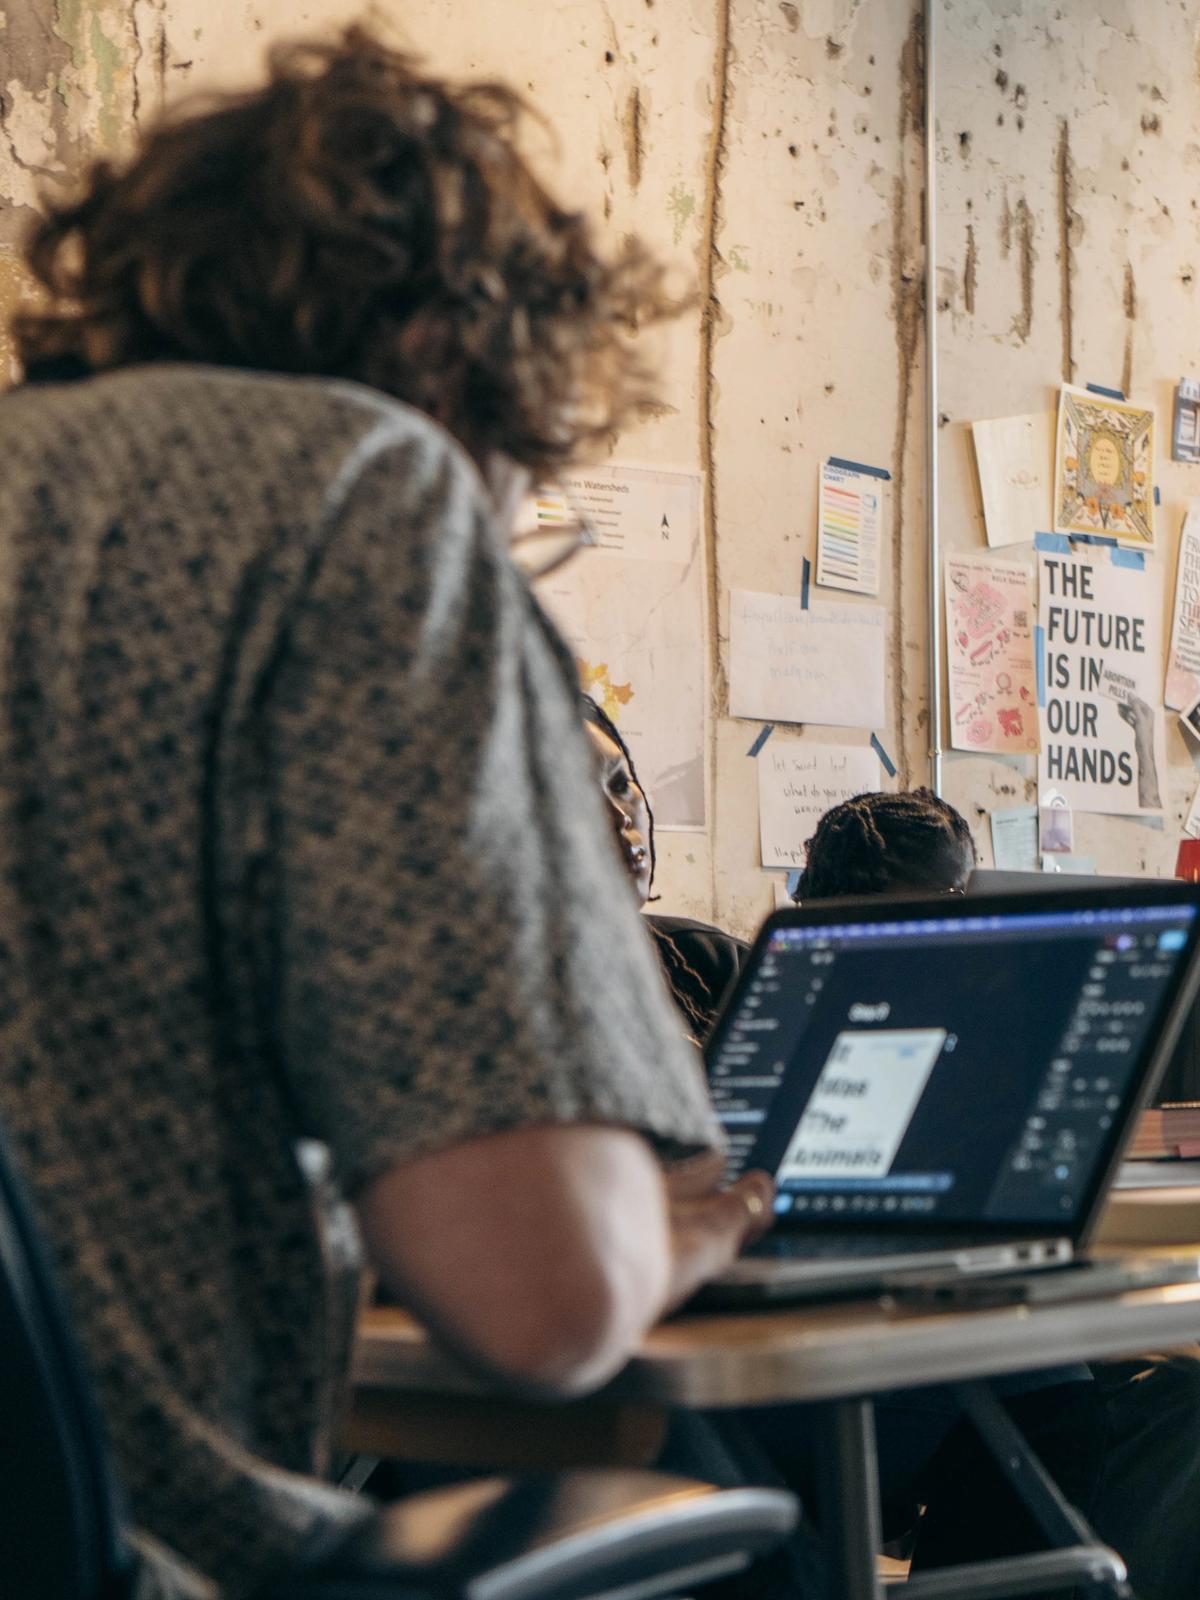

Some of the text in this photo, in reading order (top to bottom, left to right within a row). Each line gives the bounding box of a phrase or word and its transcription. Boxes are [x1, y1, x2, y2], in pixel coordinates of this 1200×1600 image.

[585, 480, 630, 494] Watersheds
[661, 530, 670, 540] N
[1044, 559, 1094, 600] THE
[1182, 584, 1200, 601] TO
[1048, 606, 1145, 653] FUTURE
[1047, 652, 1104, 692] IS IN
[1103, 669, 1137, 690] ABORTION
[1047, 698, 1098, 738] OUR
[1047, 744, 1133, 786] HANDS
